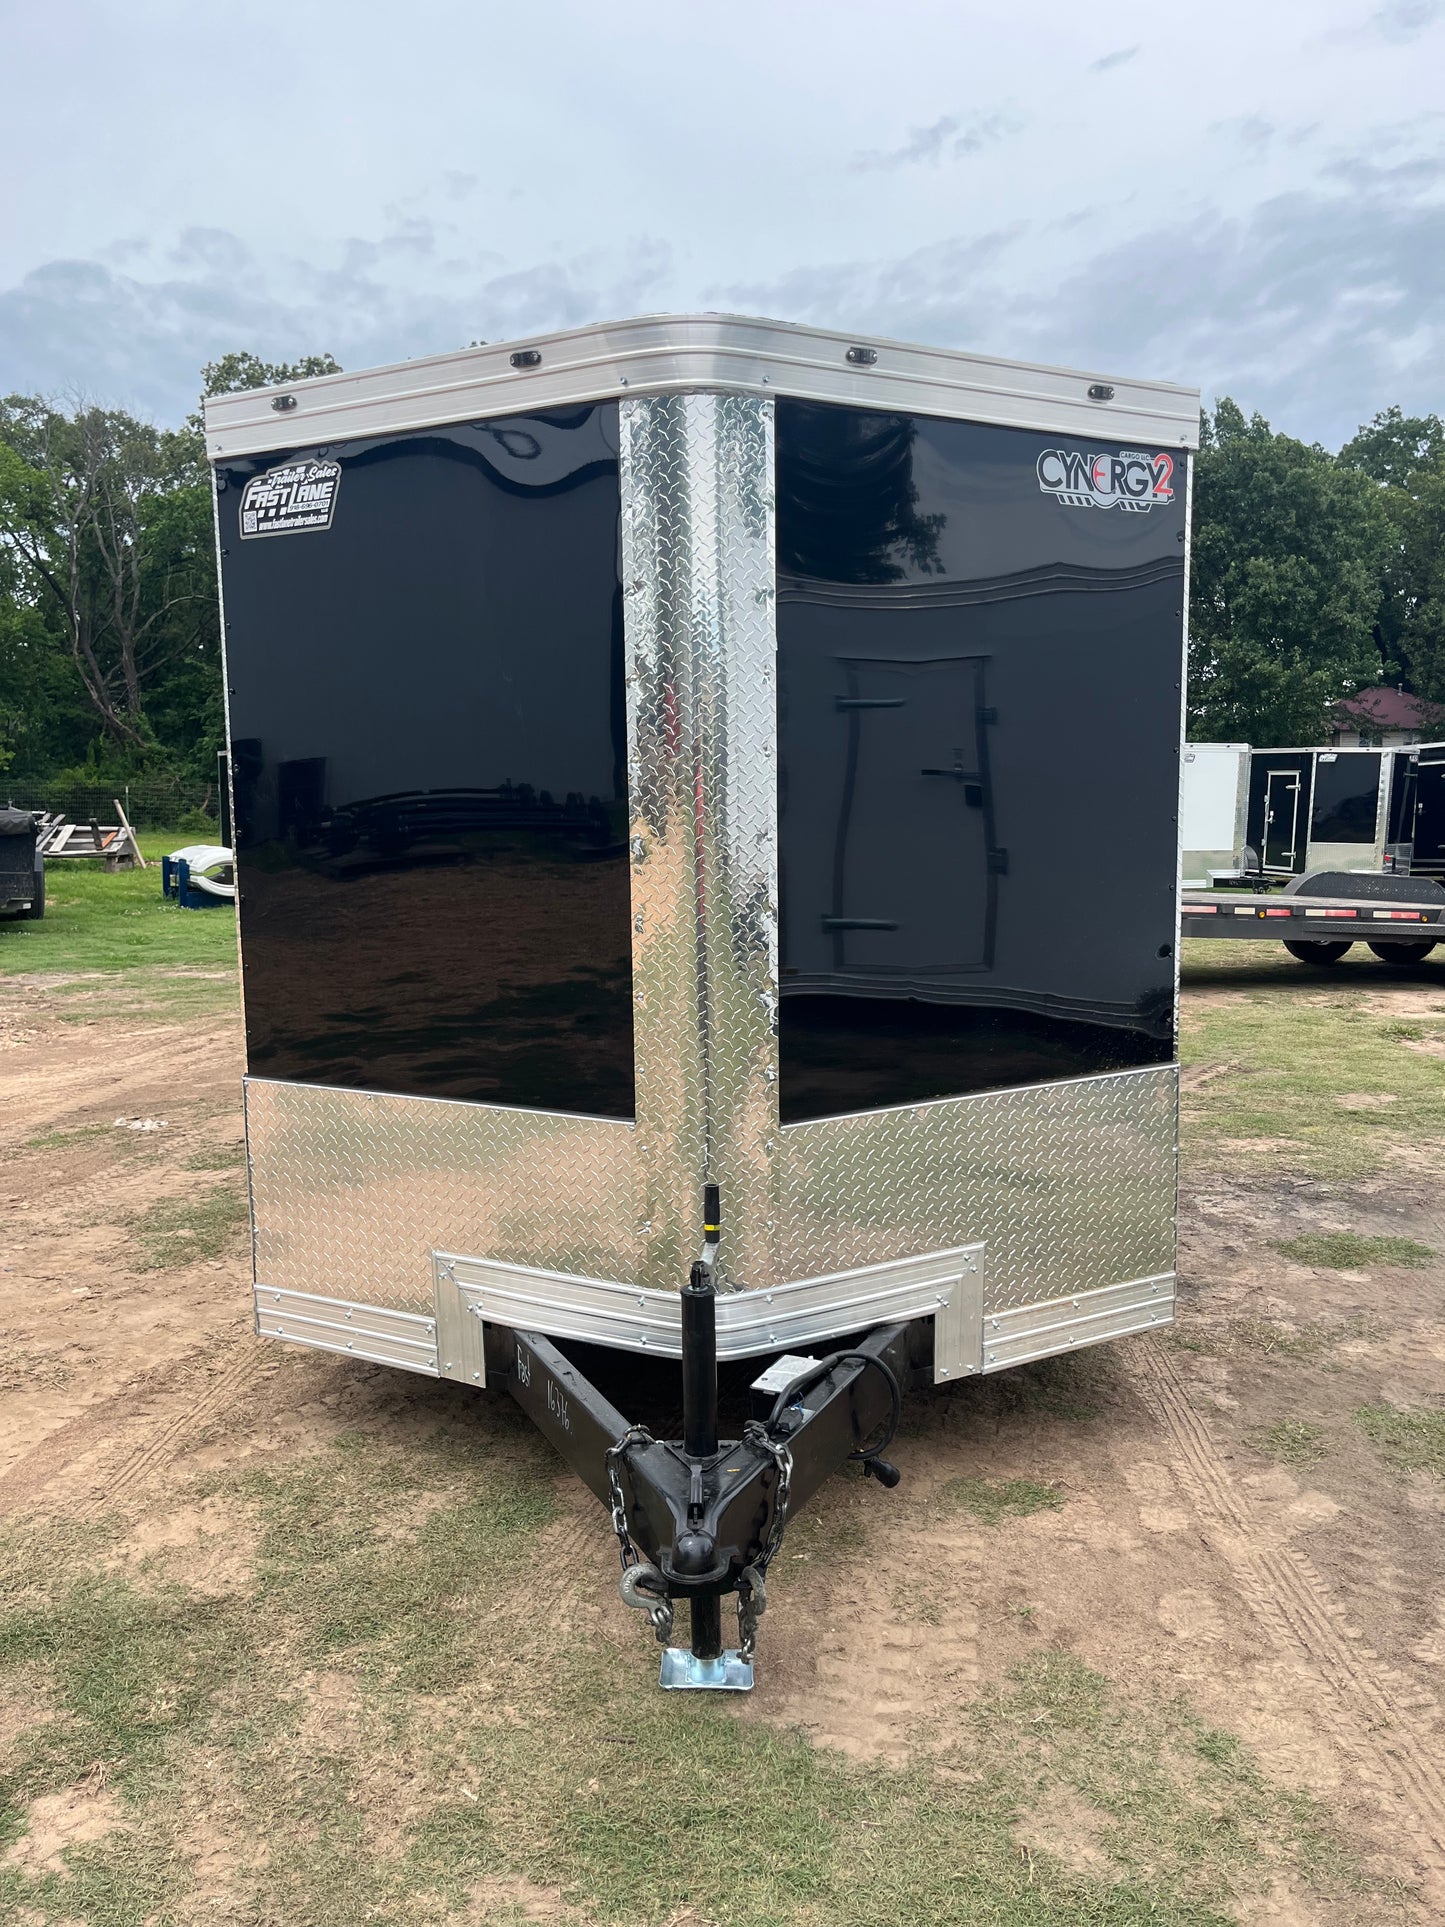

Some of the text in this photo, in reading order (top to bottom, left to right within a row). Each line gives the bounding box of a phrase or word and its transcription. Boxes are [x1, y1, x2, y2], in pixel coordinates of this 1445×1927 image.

[1120, 452, 1140, 460] CARGO
[269, 466, 338, 488] Trailer Sales
